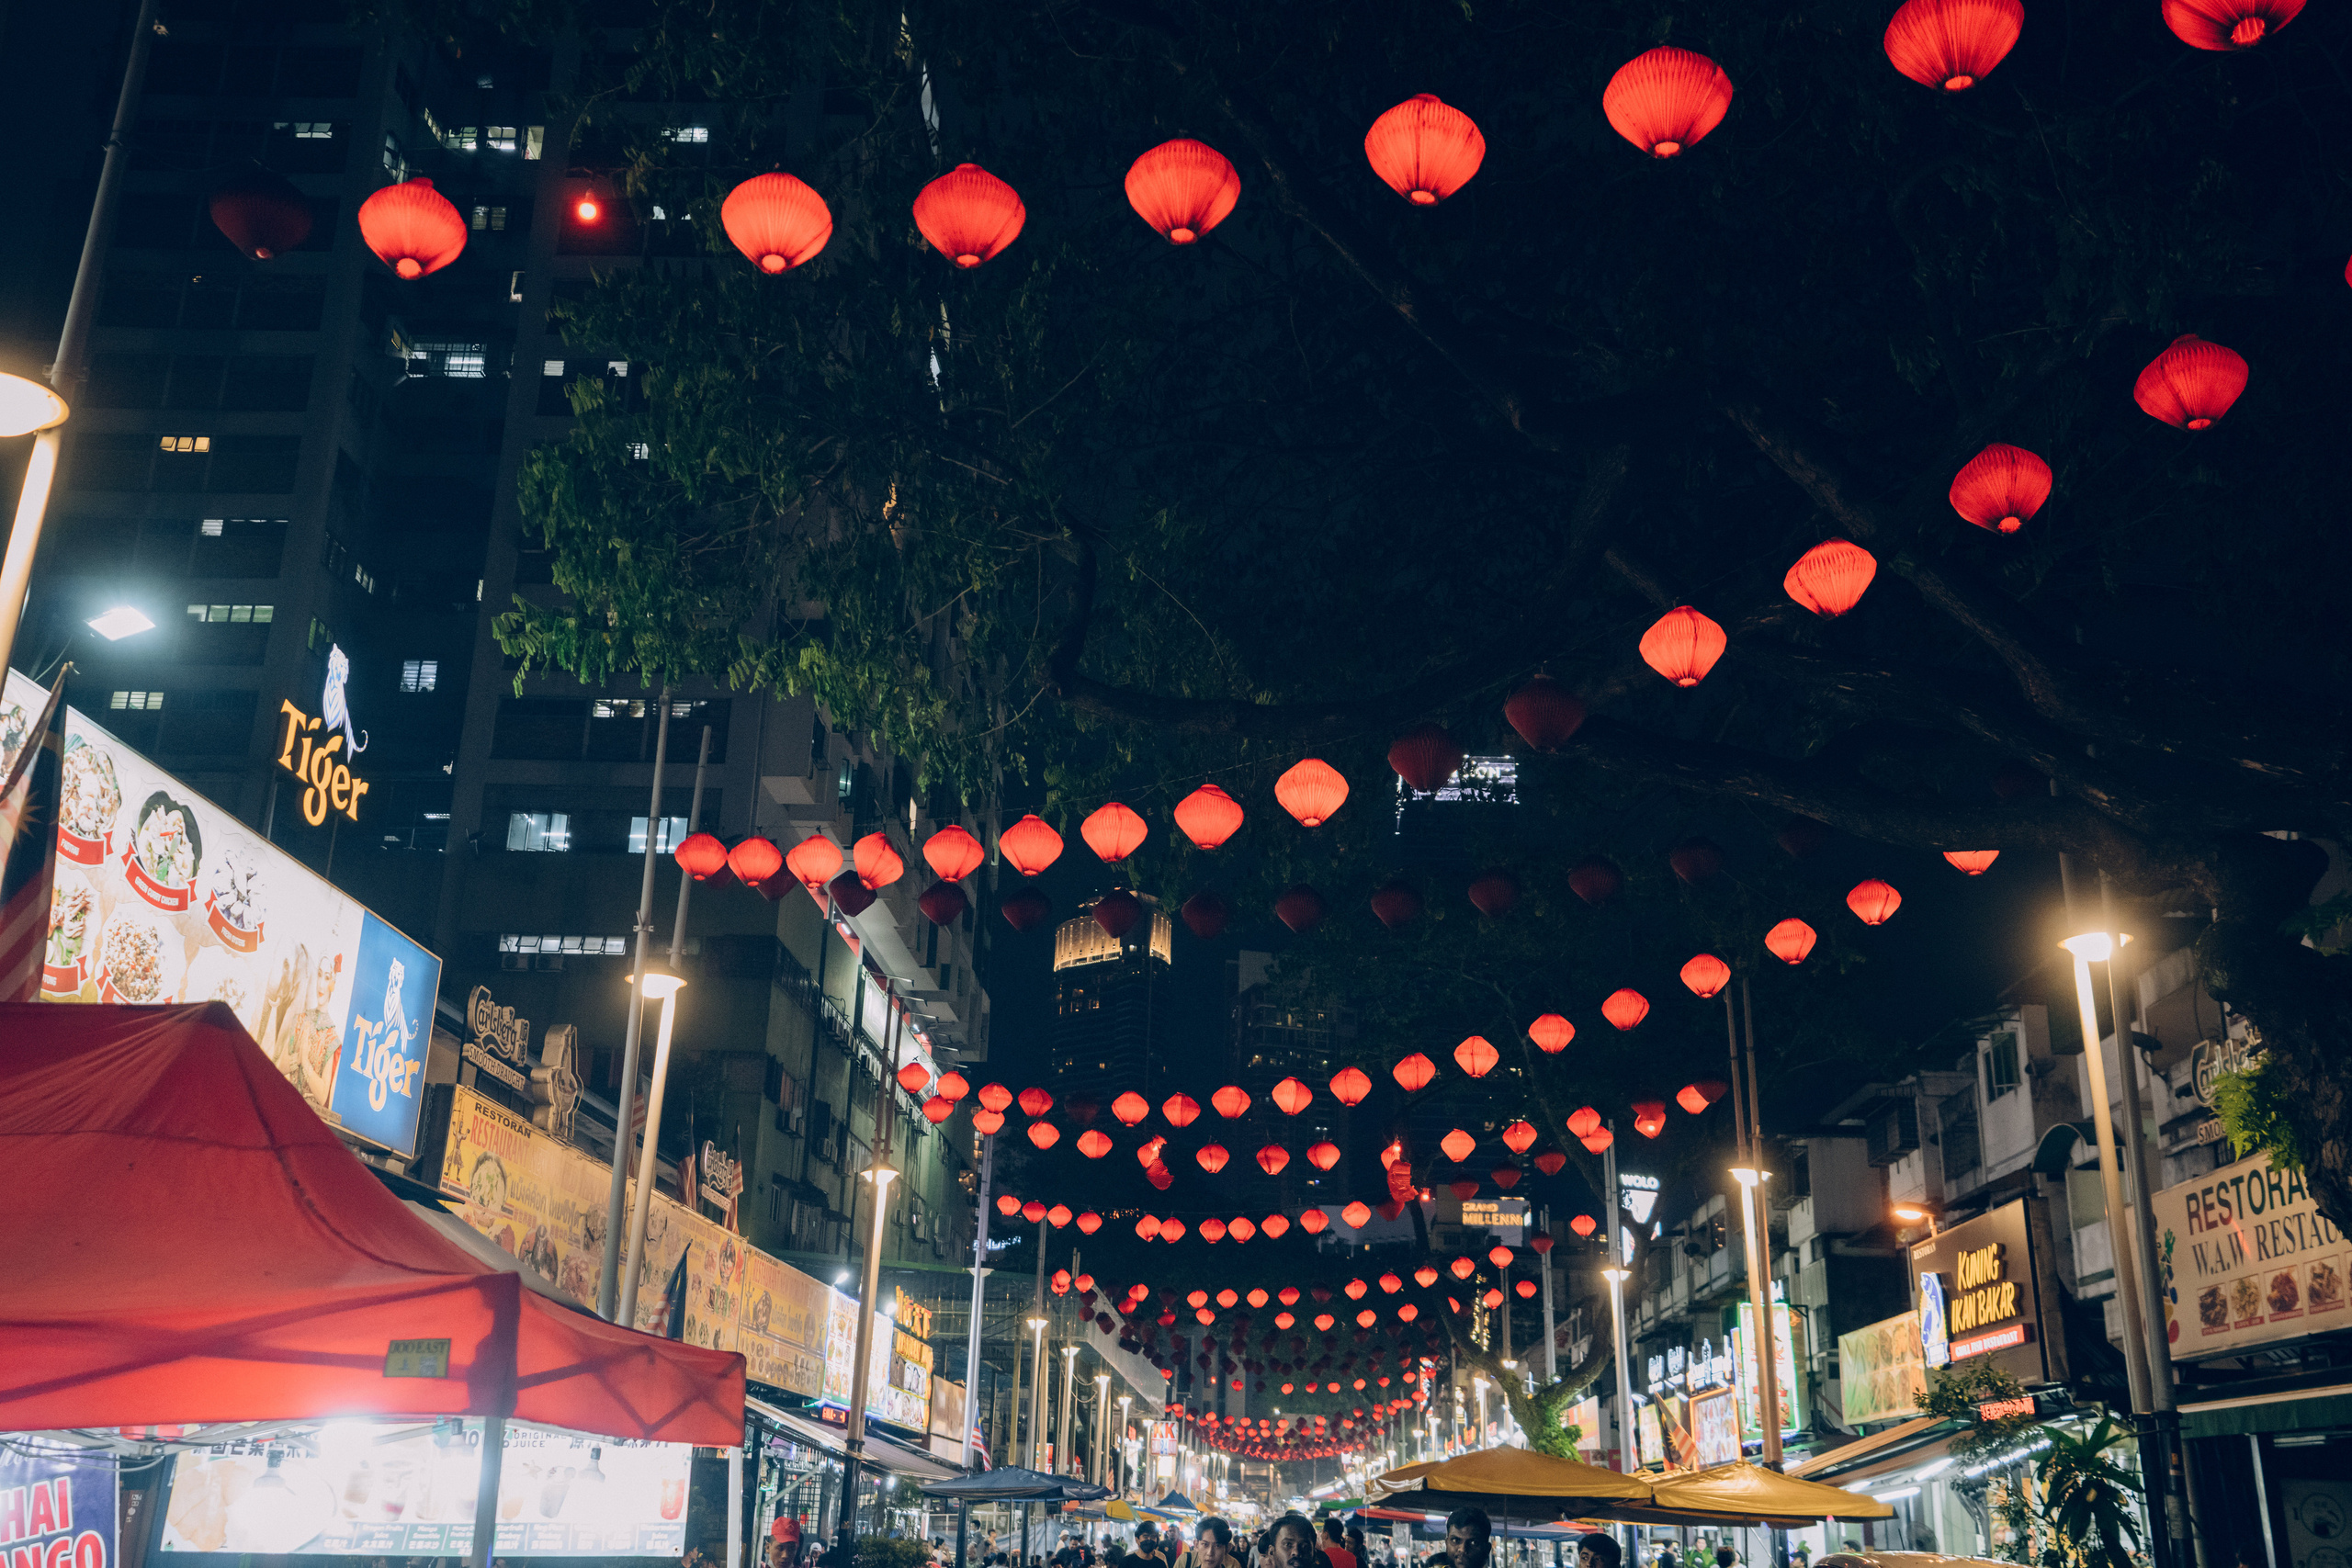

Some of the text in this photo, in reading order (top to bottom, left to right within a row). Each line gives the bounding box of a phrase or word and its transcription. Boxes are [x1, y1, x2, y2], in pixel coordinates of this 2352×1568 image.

[277, 698, 369, 827] Tiger
[474, 985, 517, 1056] Carlsberg
[350, 1013, 421, 1111] Tiger
[469, 1045, 525, 1090] SMOOTH DRAUGHT
[469, 1114, 531, 1168] RESTAURANT
[474, 1101, 532, 1139] RESTORAN
[1620, 1173, 1660, 1189] WOLO
[2186, 1164, 2307, 1236] RESTORA
[1463, 1202, 1498, 1213] GRAND
[1957, 1242, 2000, 1292] KUNING
[2192, 1230, 2245, 1279] W.A.W
[1951, 1281, 2016, 1335] IKAN BAKAR
[1983, 1330, 2018, 1350] RESTAURANT
[513, 1440, 546, 1449] JUICE
[1153, 1422, 1175, 1438] KK
[0, 1476, 73, 1547] HAI
